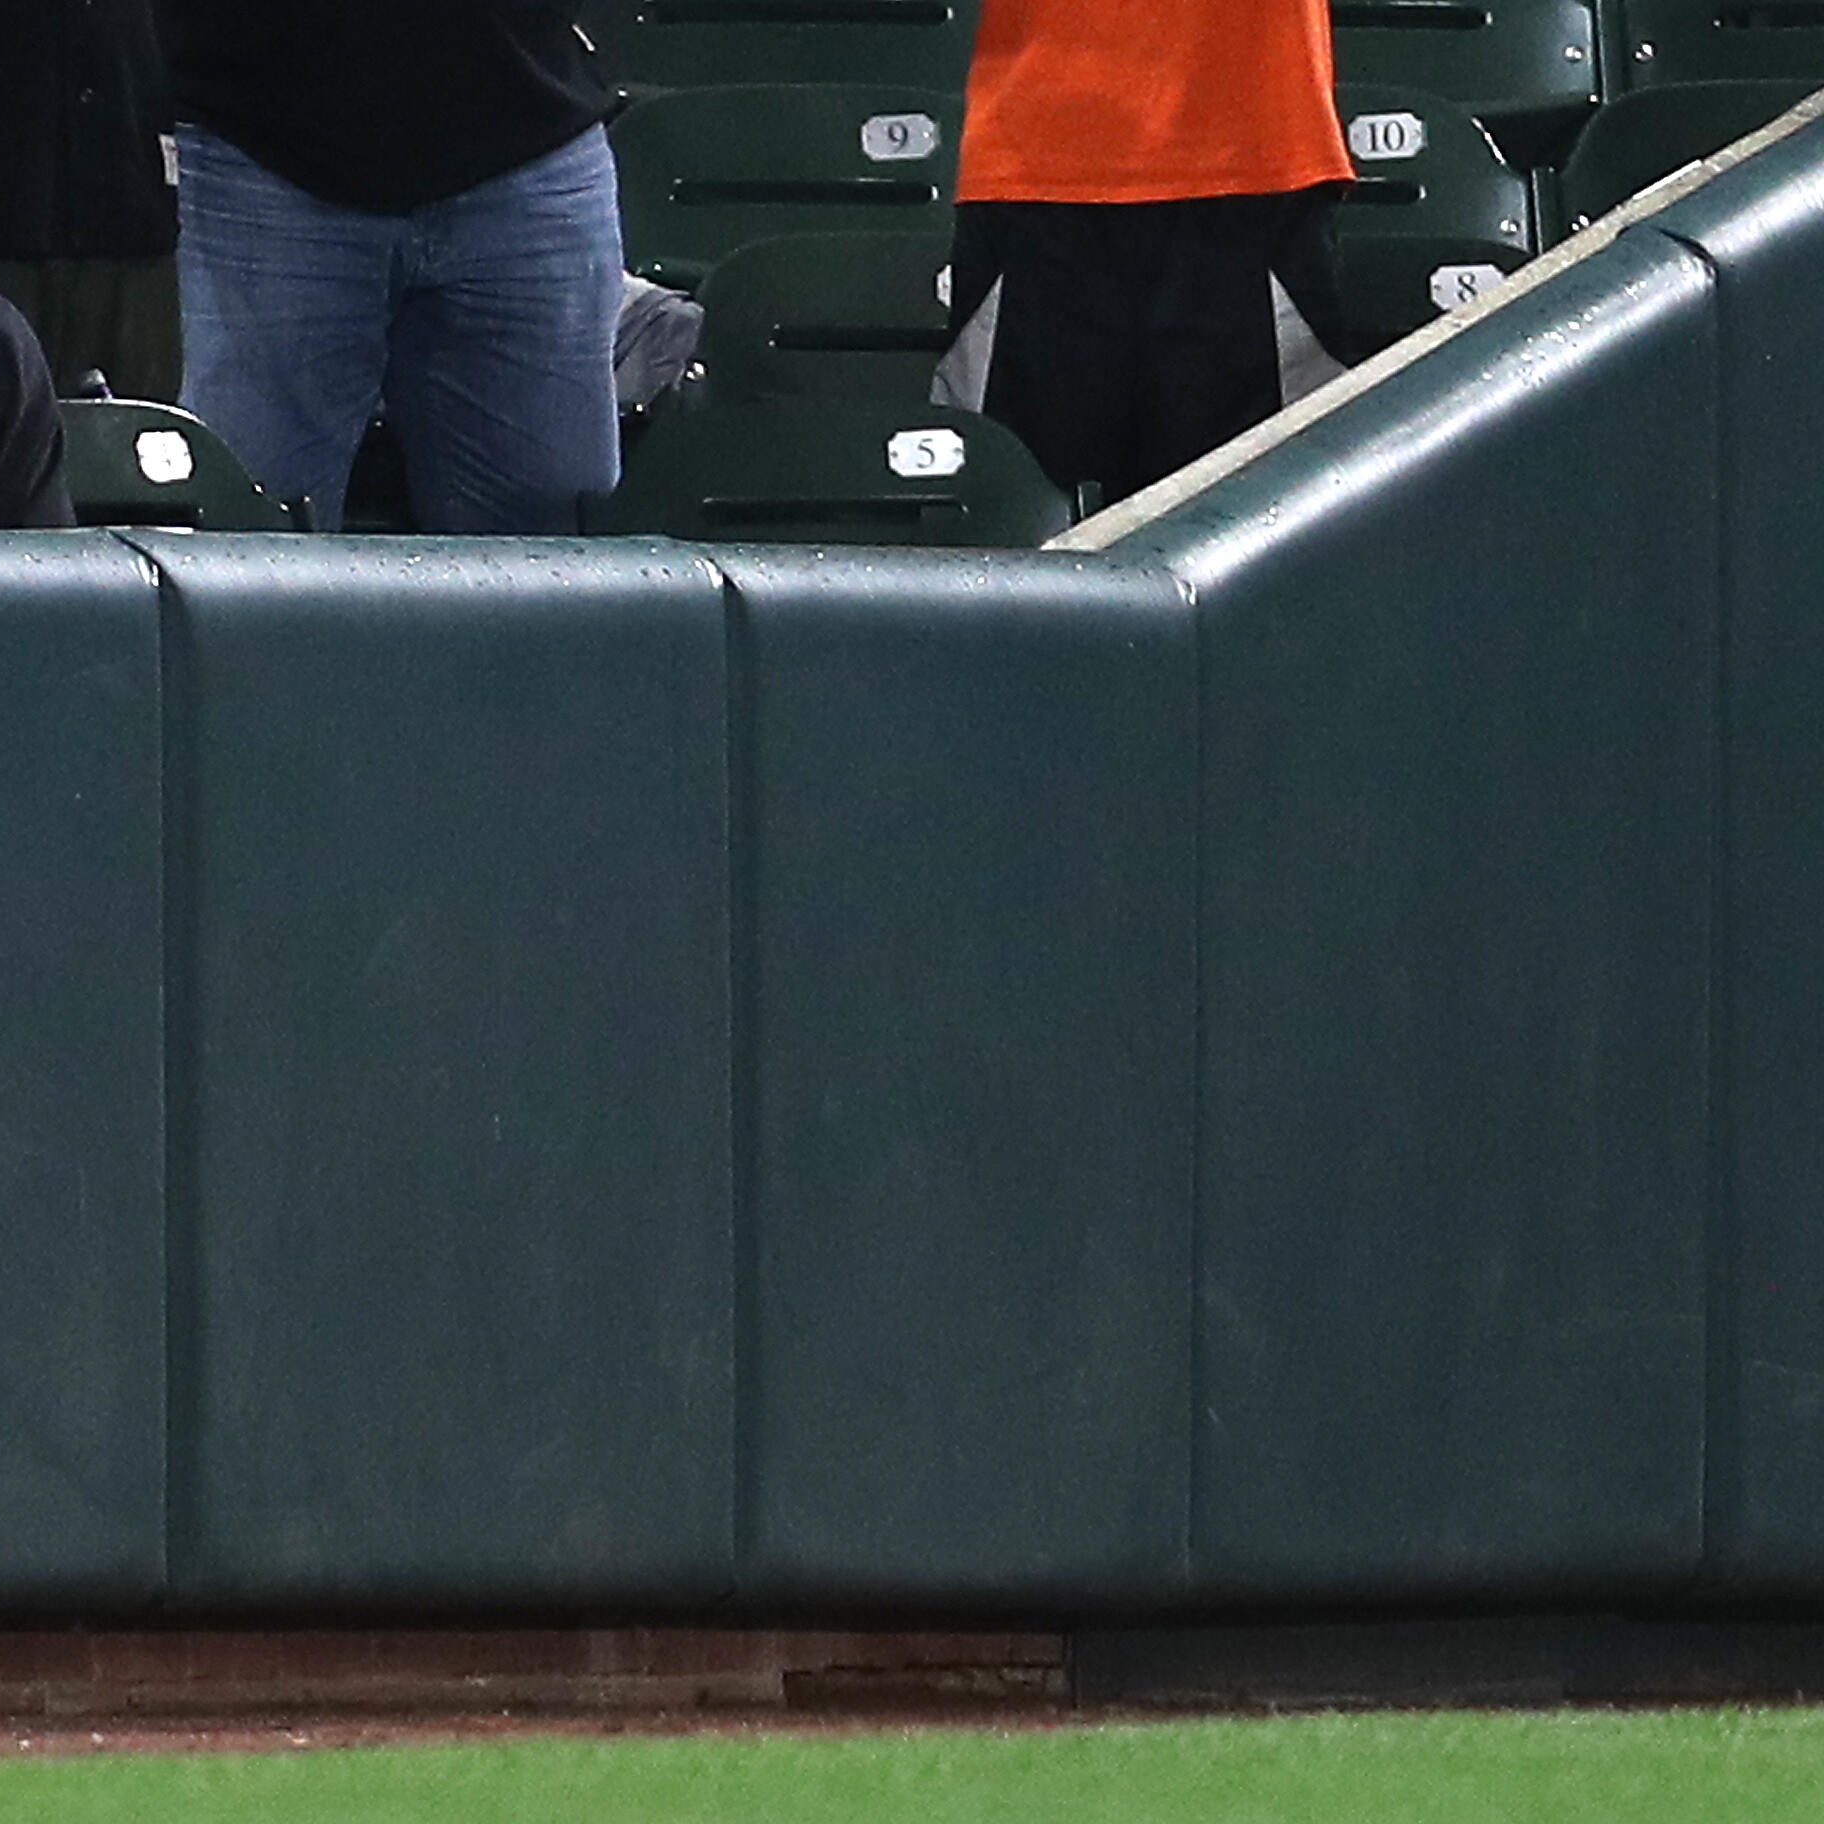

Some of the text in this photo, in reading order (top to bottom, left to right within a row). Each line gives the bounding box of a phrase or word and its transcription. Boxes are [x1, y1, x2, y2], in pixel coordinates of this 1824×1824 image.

[887, 122, 908, 152] 9
[1367, 121, 1404, 152] 10
[1457, 272, 1476, 302] 8
[916, 438, 936, 469] 5
